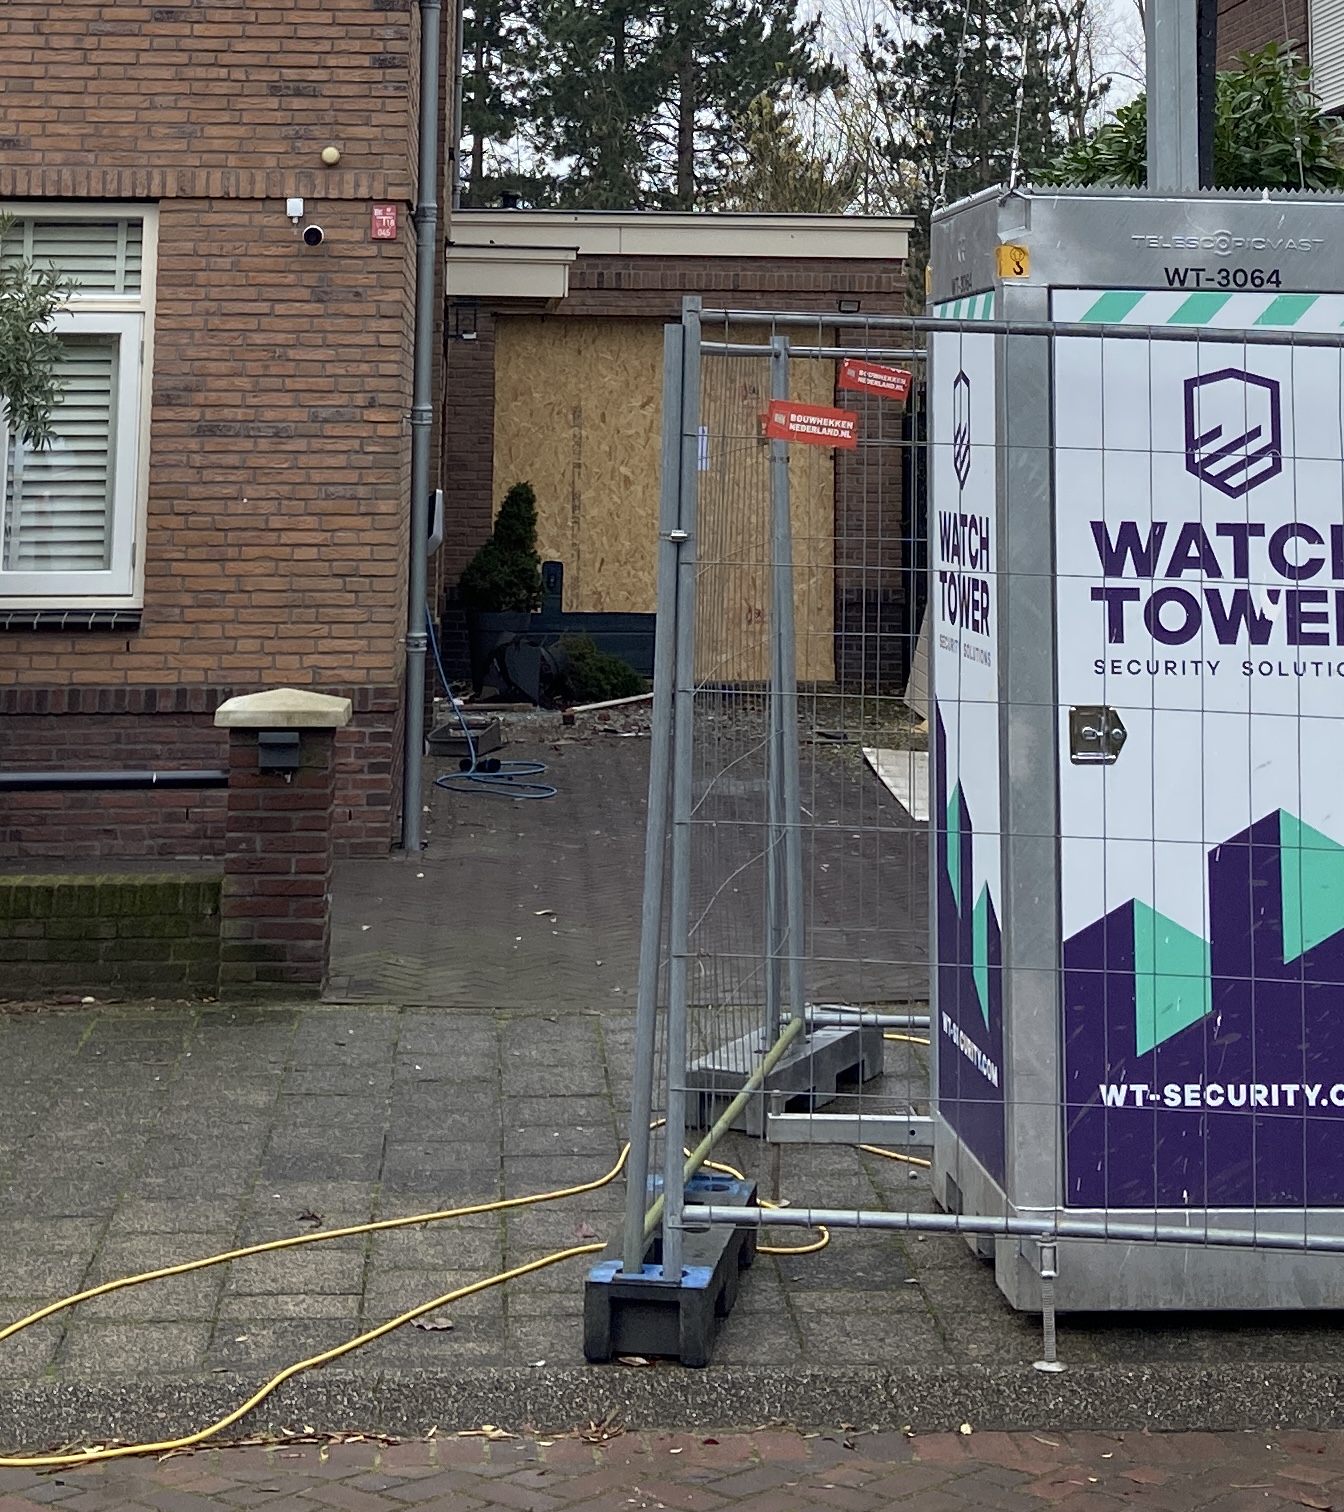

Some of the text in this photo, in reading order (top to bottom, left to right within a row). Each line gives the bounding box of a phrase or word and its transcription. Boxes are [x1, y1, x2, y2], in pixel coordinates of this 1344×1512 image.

[1164, 267, 1283, 288] WT-3064
[789, 422, 852, 438] NEDERLAND.NL
[790, 413, 854, 429] BOUWHEKKEN
[938, 510, 990, 573] WATCH
[939, 570, 991, 638] TOWER
[1093, 659, 1221, 677] SECURITY
